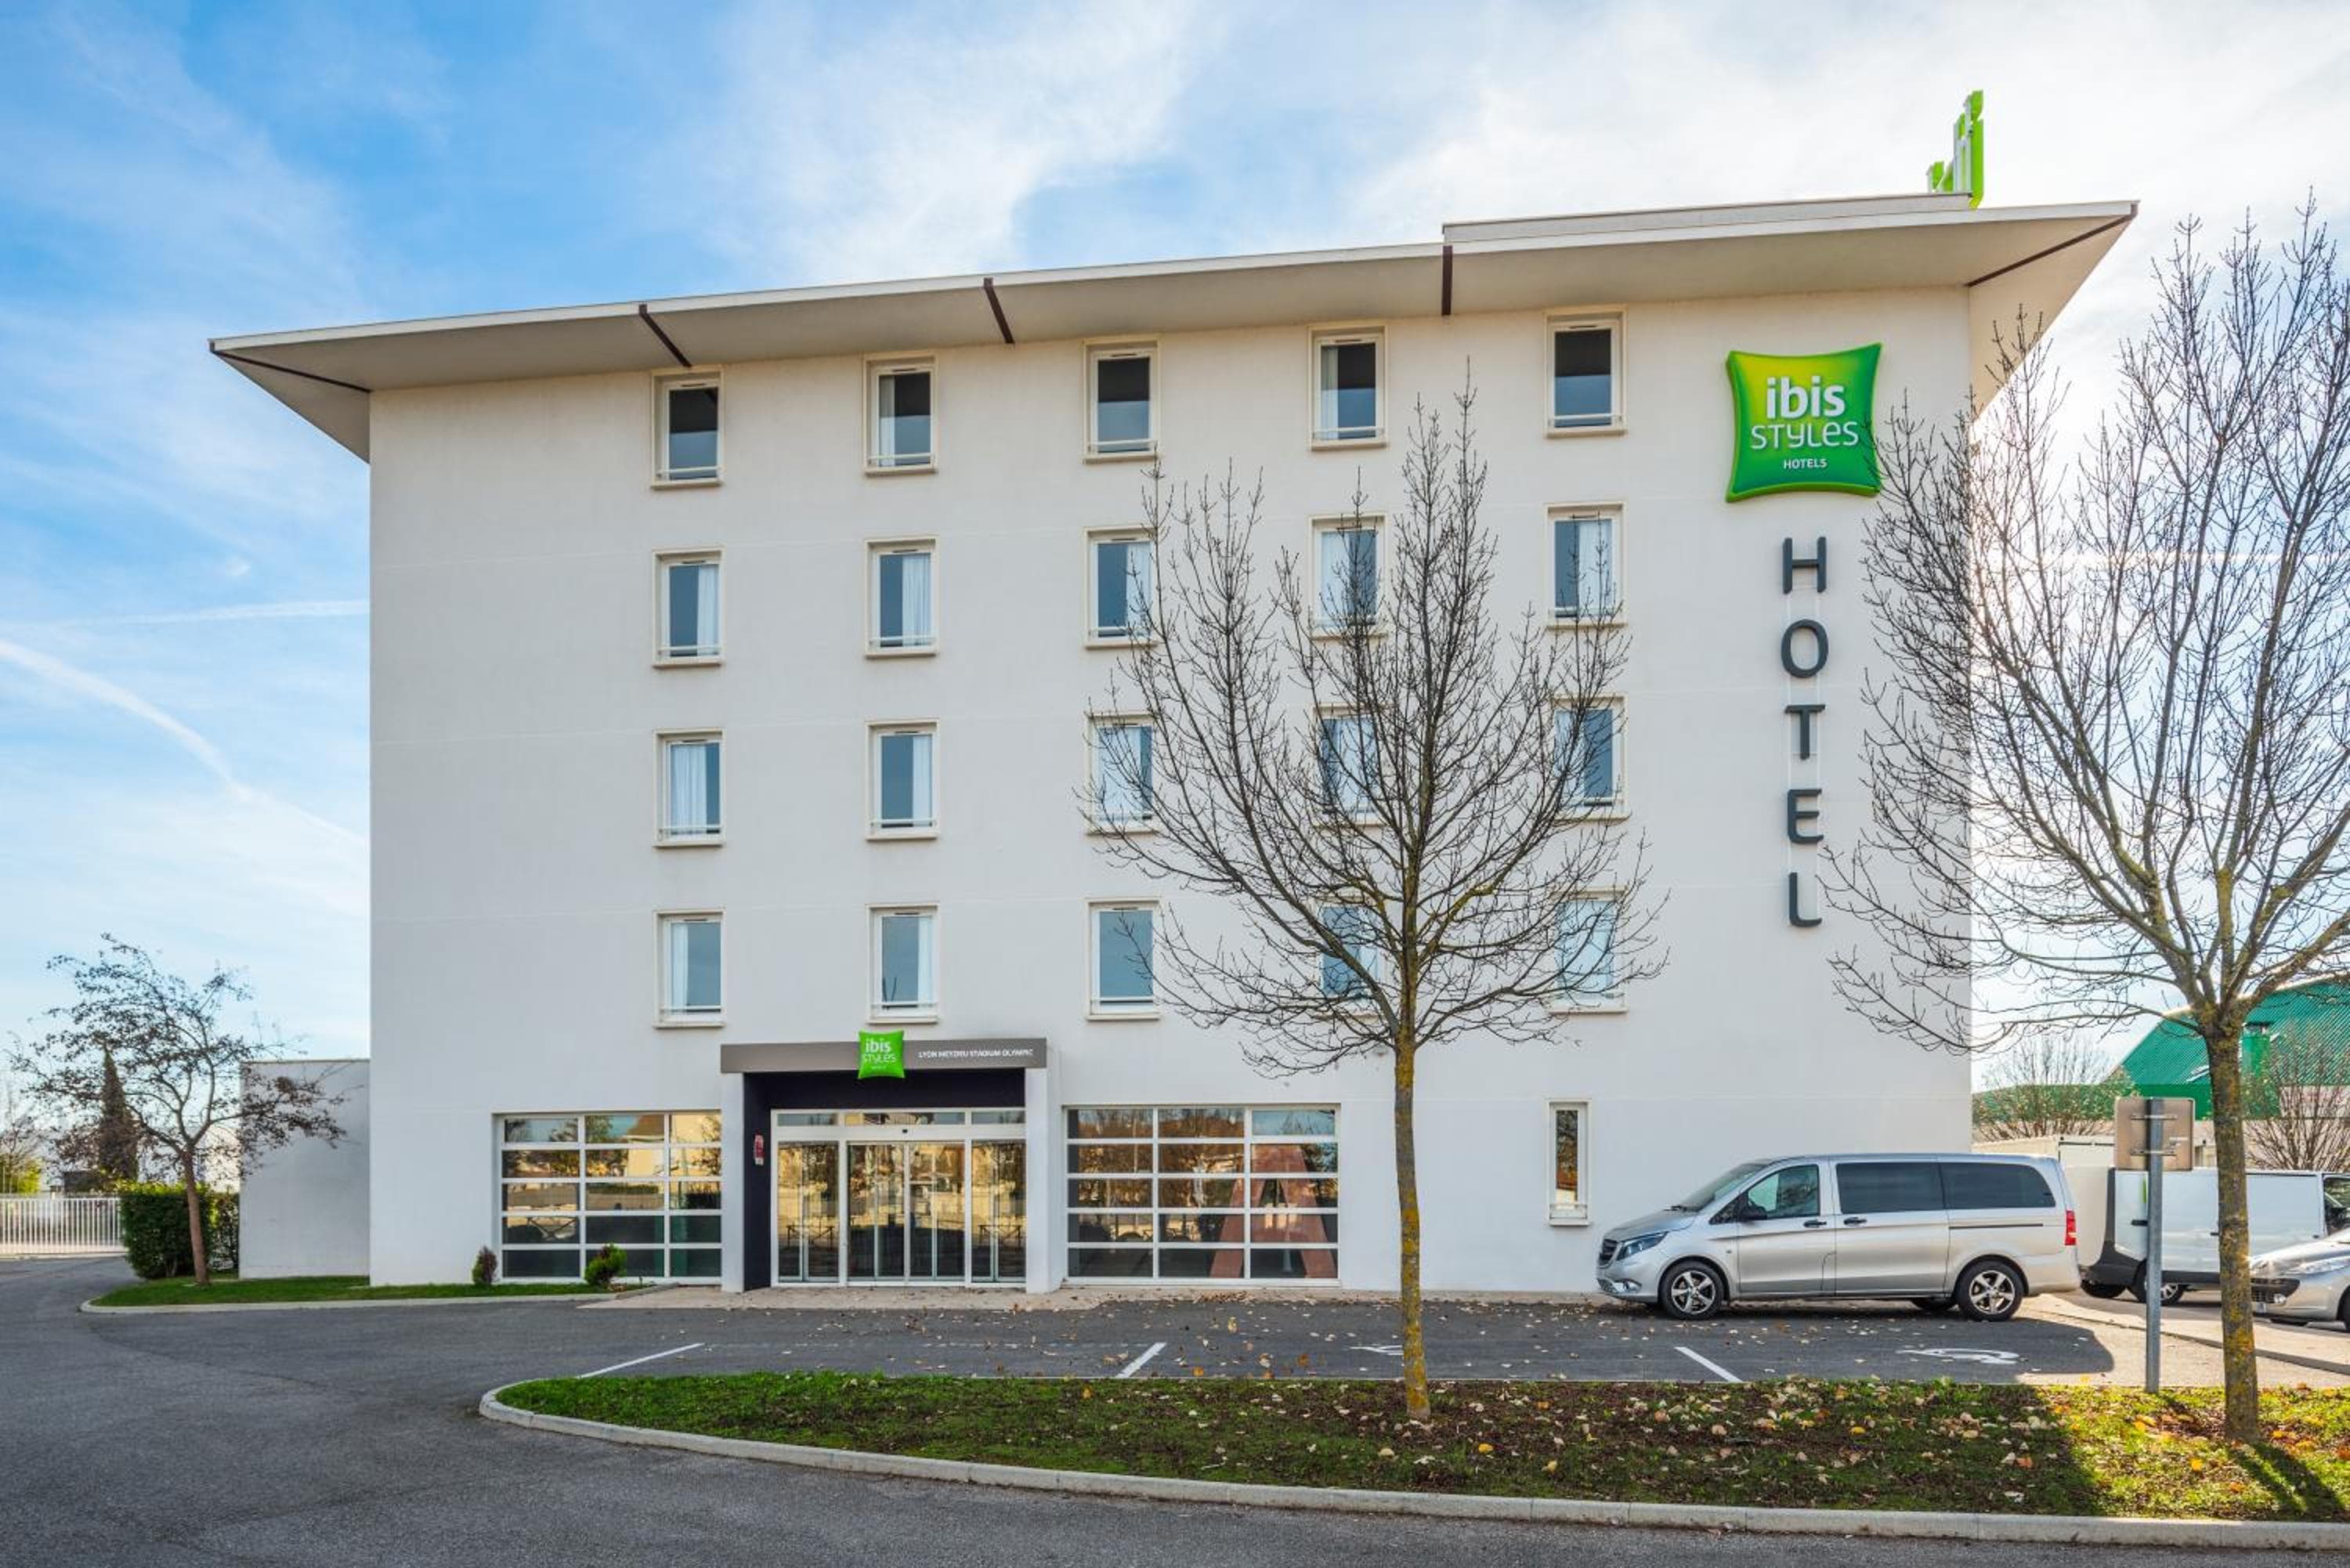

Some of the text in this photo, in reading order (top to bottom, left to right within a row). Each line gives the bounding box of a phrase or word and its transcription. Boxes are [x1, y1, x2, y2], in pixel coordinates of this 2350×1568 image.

[1766, 376, 1846, 419] ibis
[1784, 458, 1828, 469] HOTELS
[1781, 536, 1829, 928] HOTEL
[865, 1038, 891, 1053] ibis
